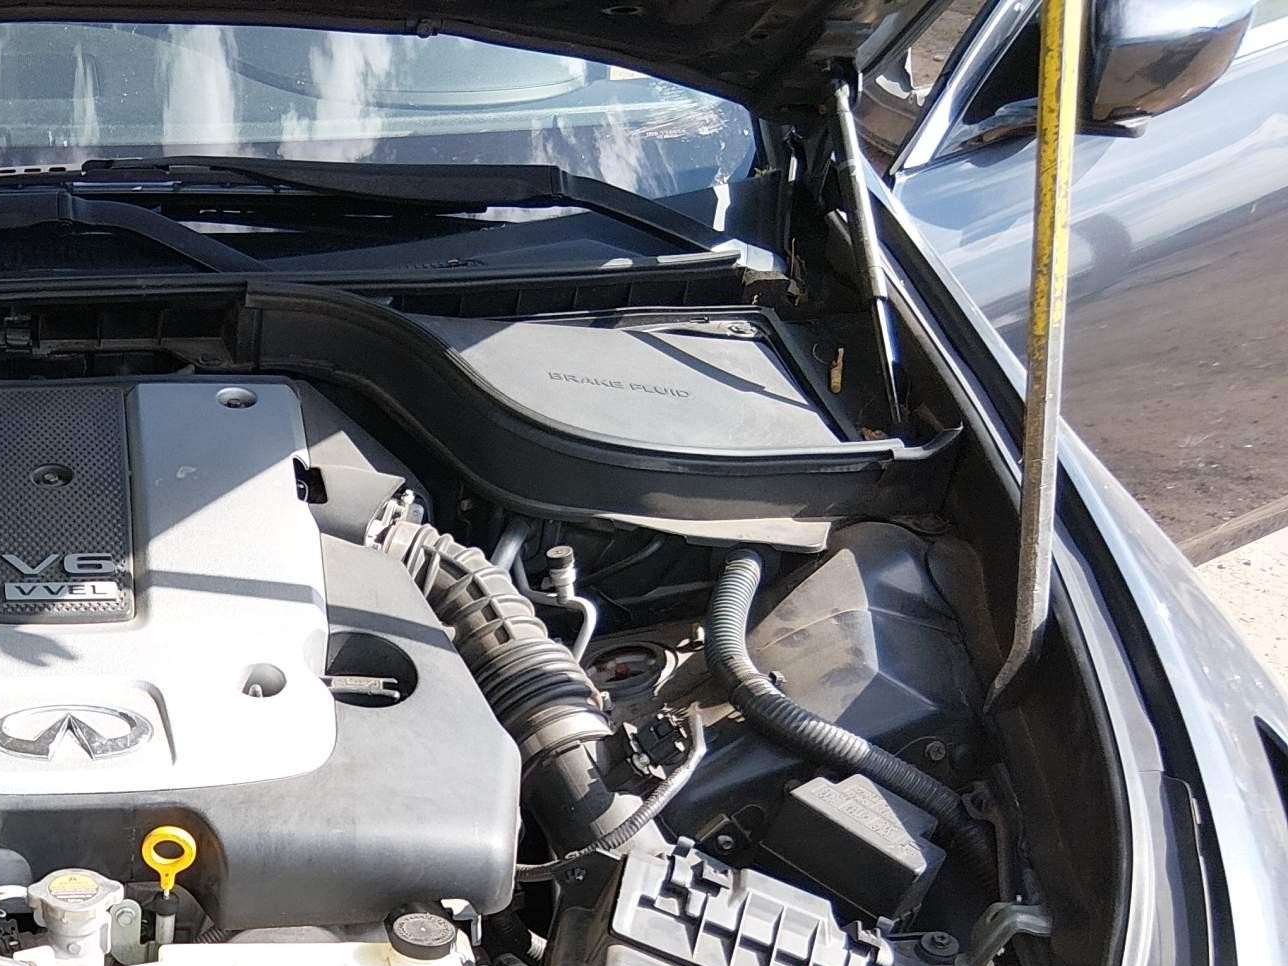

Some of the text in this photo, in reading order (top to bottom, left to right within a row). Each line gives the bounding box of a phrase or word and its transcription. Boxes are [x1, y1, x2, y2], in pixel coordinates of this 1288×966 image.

[547, 370, 690, 399] BRAKE FLUID
[0, 553, 116, 577] V6
[14, 584, 108, 596] VVEL
